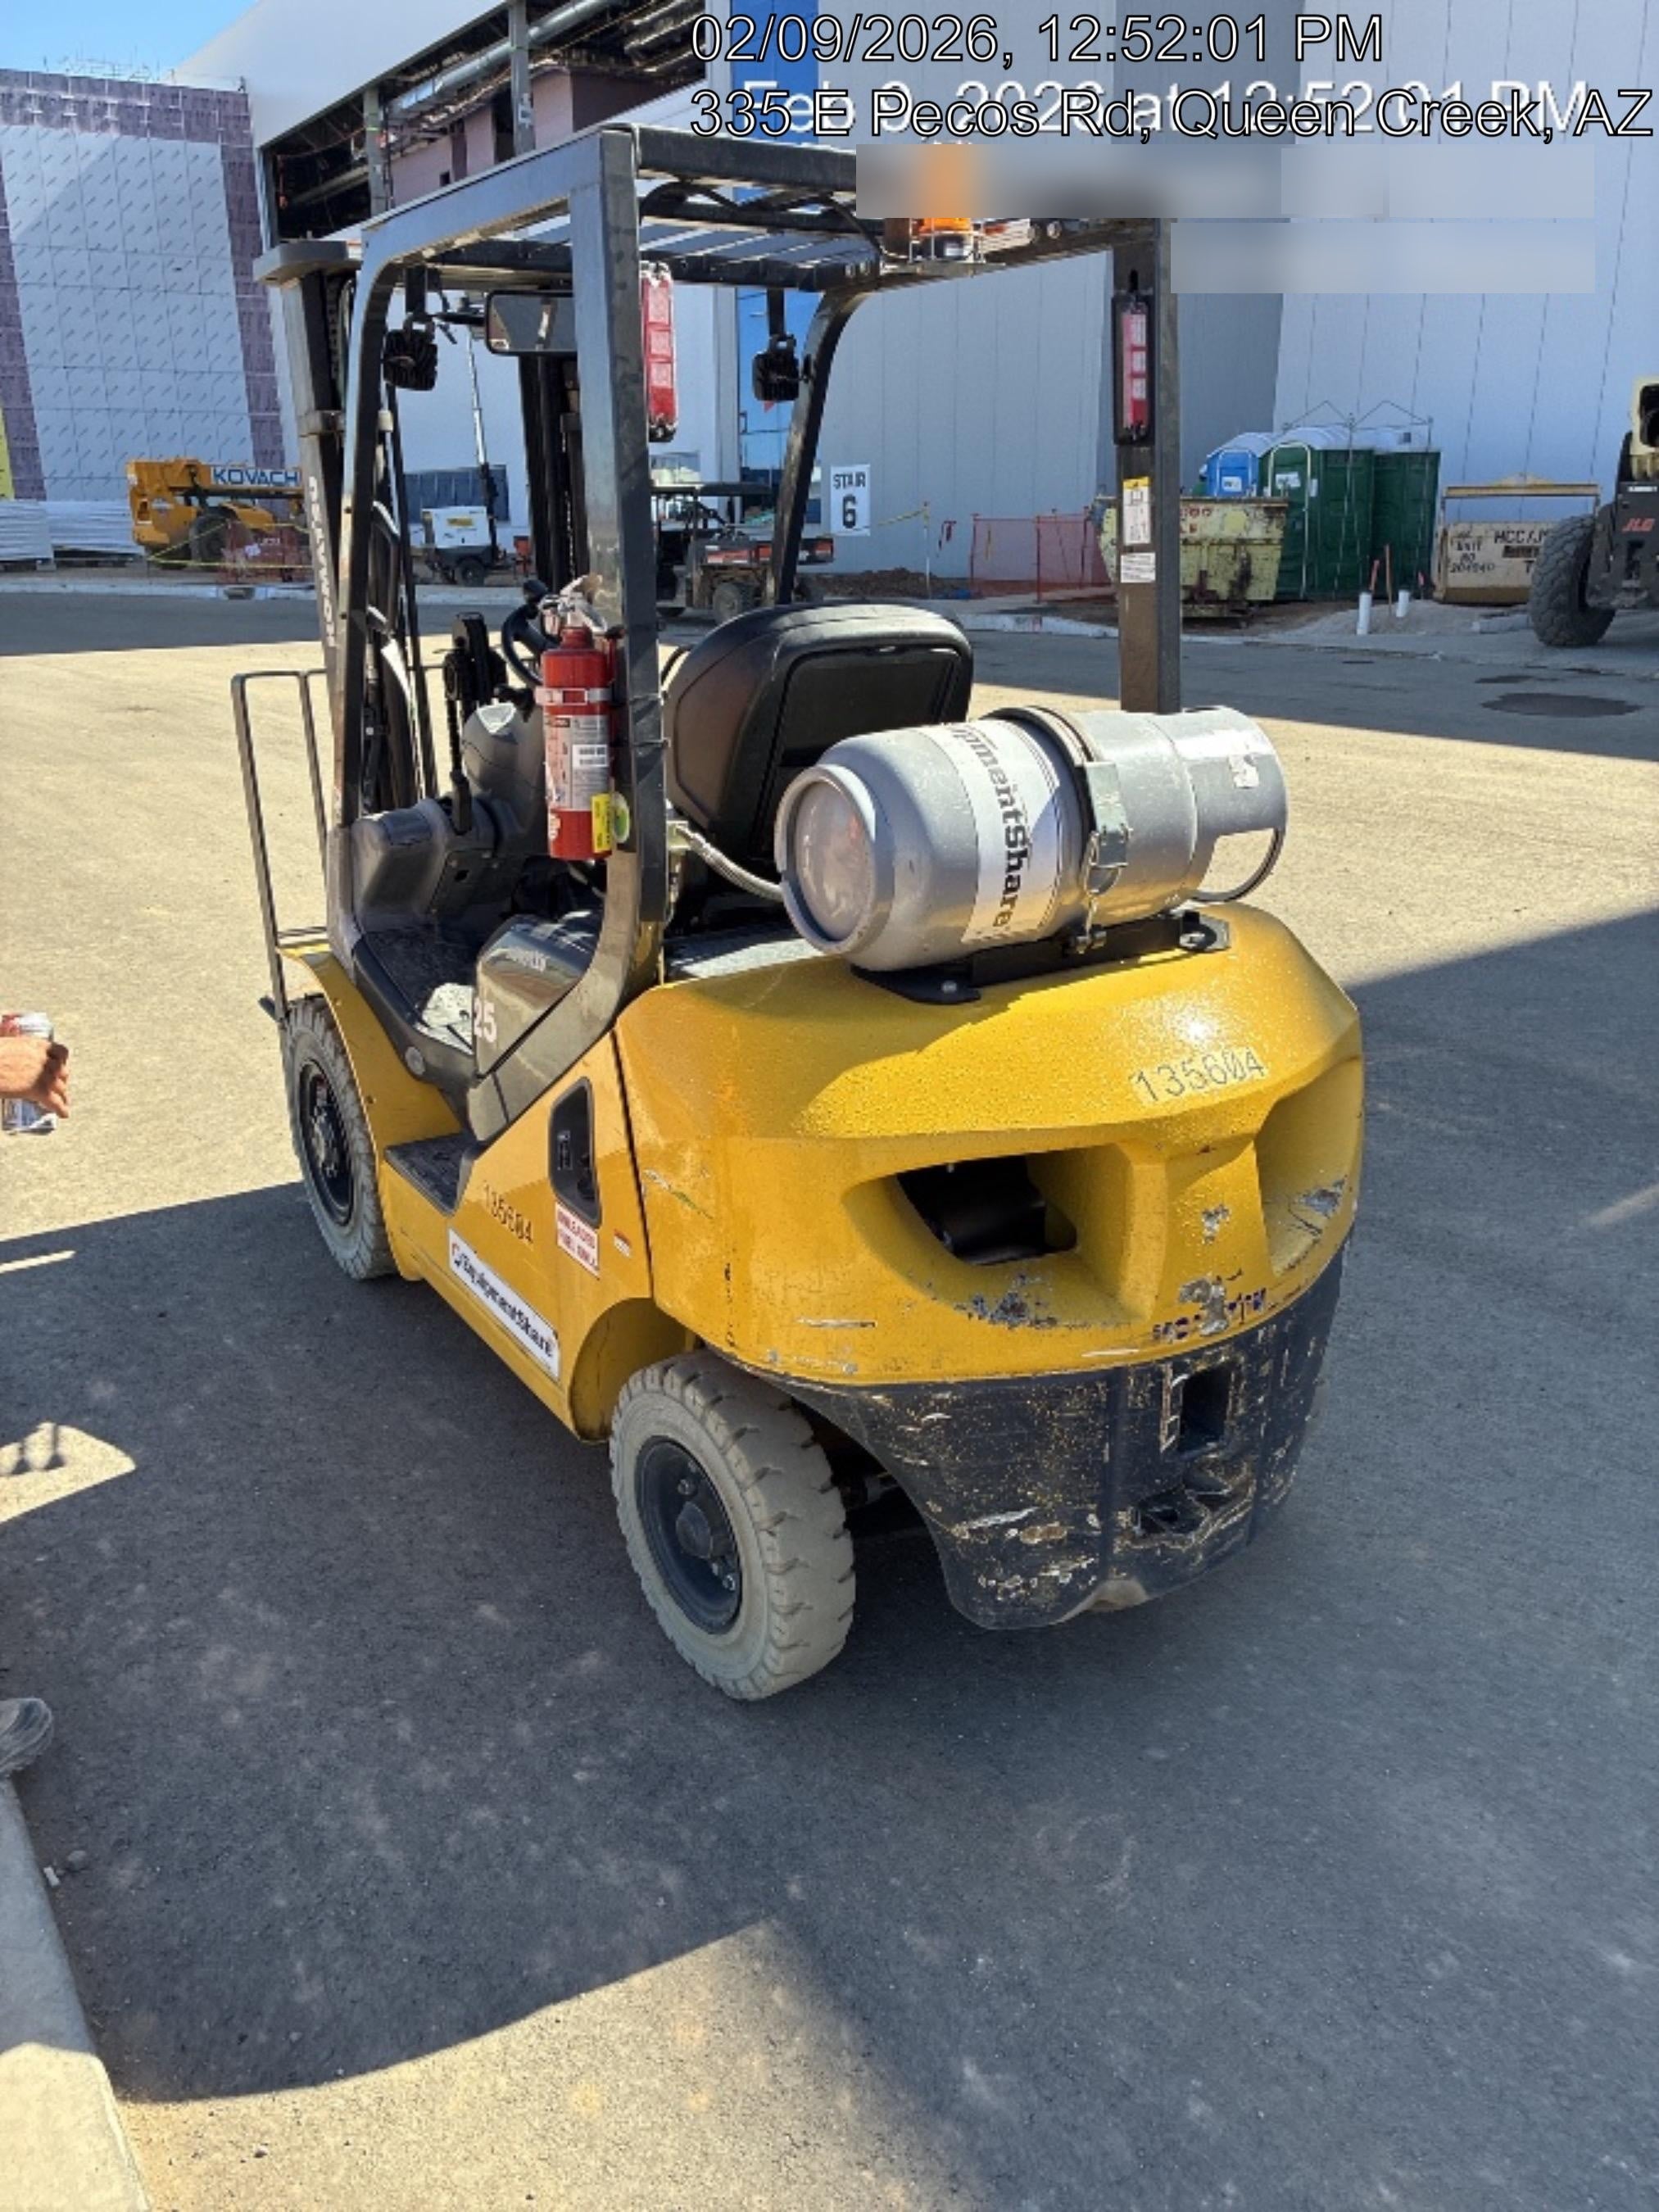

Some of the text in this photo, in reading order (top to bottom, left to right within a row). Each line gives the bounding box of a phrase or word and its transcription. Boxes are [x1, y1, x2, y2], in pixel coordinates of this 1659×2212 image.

[213, 469, 298, 485] KOVACH
[832, 471, 866, 490] STAIR
[842, 493, 858, 529] 6
